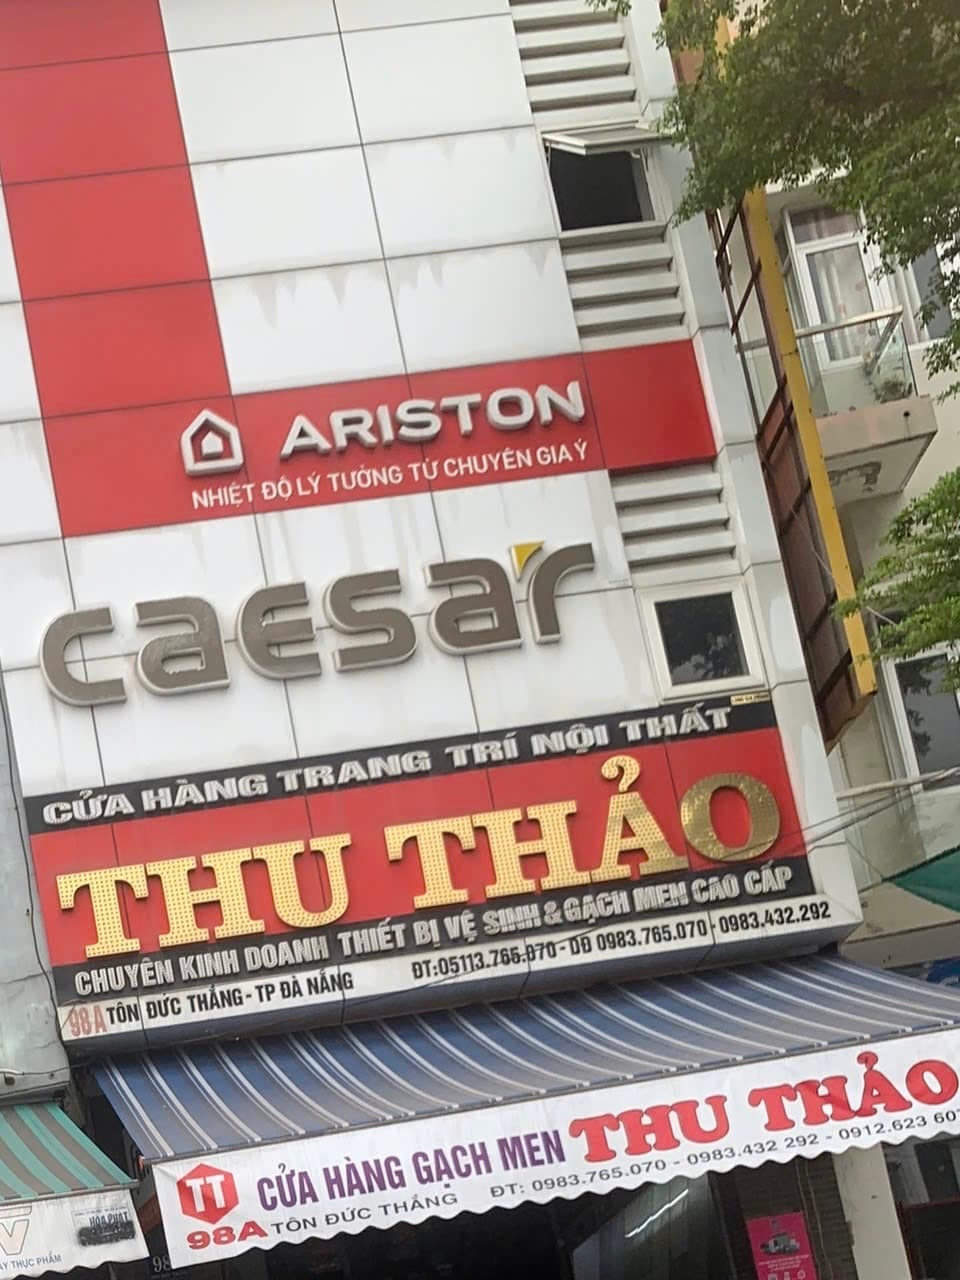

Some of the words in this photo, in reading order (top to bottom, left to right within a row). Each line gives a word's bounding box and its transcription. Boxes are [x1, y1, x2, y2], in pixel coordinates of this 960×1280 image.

[192, 482, 254, 509] NHIỆT
[261, 477, 292, 501] ĐỘ
[296, 472, 320, 495] LÝ
[408, 459, 440, 480] TỪ
[444, 445, 531, 477] CHUYÊN
[537, 446, 570, 468] GIA
[573, 439, 588, 461] Ý
[280, 381, 587, 458] ARISTON
[41, 540, 596, 707] caesar
[42, 789, 135, 826] CỬA
[141, 773, 268, 811] HÀNG
[276, 750, 432, 792] TRANG
[445, 731, 520, 768] TRÍ
[531, 722, 610, 757] NỘI
[619, 704, 731, 744] THẤT
[56, 833, 352, 959] THU
[384, 755, 781, 909] THẢO
[74, 957, 175, 996] CHUYÊN
[179, 955, 241, 982] KINH
[244, 935, 330, 971] DOANH
[337, 916, 406, 957] THIẾT
[413, 918, 440, 948] BỊ
[444, 909, 478, 942] VỆ
[482, 902, 541, 936] SINH
[543, 900, 563, 925] &
[564, 890, 631, 924] GẠCH
[632, 881, 689, 913] MEN
[692, 873, 741, 903] CAO
[743, 860, 792, 894] CẤP
[596, 919, 708, 952] 0983.765.070
[720, 901, 832, 934] 0983.432.292
[106, 1000, 140, 1025] TÔN
[146, 992, 182, 1019] ĐỨC
[255, 984, 276, 1004] TP
[279, 976, 304, 999] ĐÀ
[186, 1219, 268, 1251] 98A
[270, 1216, 318, 1236] TÔN
[325, 1205, 372, 1227] ĐỨC
[490, 1181, 525, 1198] ĐT:
[531, 1157, 667, 1192] 0983.765.070
[687, 1139, 778, 1166] 0983.432
[784, 1132, 820, 1149] 292
[838, 1113, 929, 1141] 0912.623
[933, 1108, 960, 1124] 60
[257, 1163, 319, 1211] CỬA
[323, 1156, 406, 1200] HÀNG
[411, 1141, 493, 1190] GẠCH
[497, 1128, 567, 1173] MEN
[568, 1095, 730, 1164] THU
[748, 1050, 960, 1134] THẢO
[186, 1174, 226, 1213] TT
